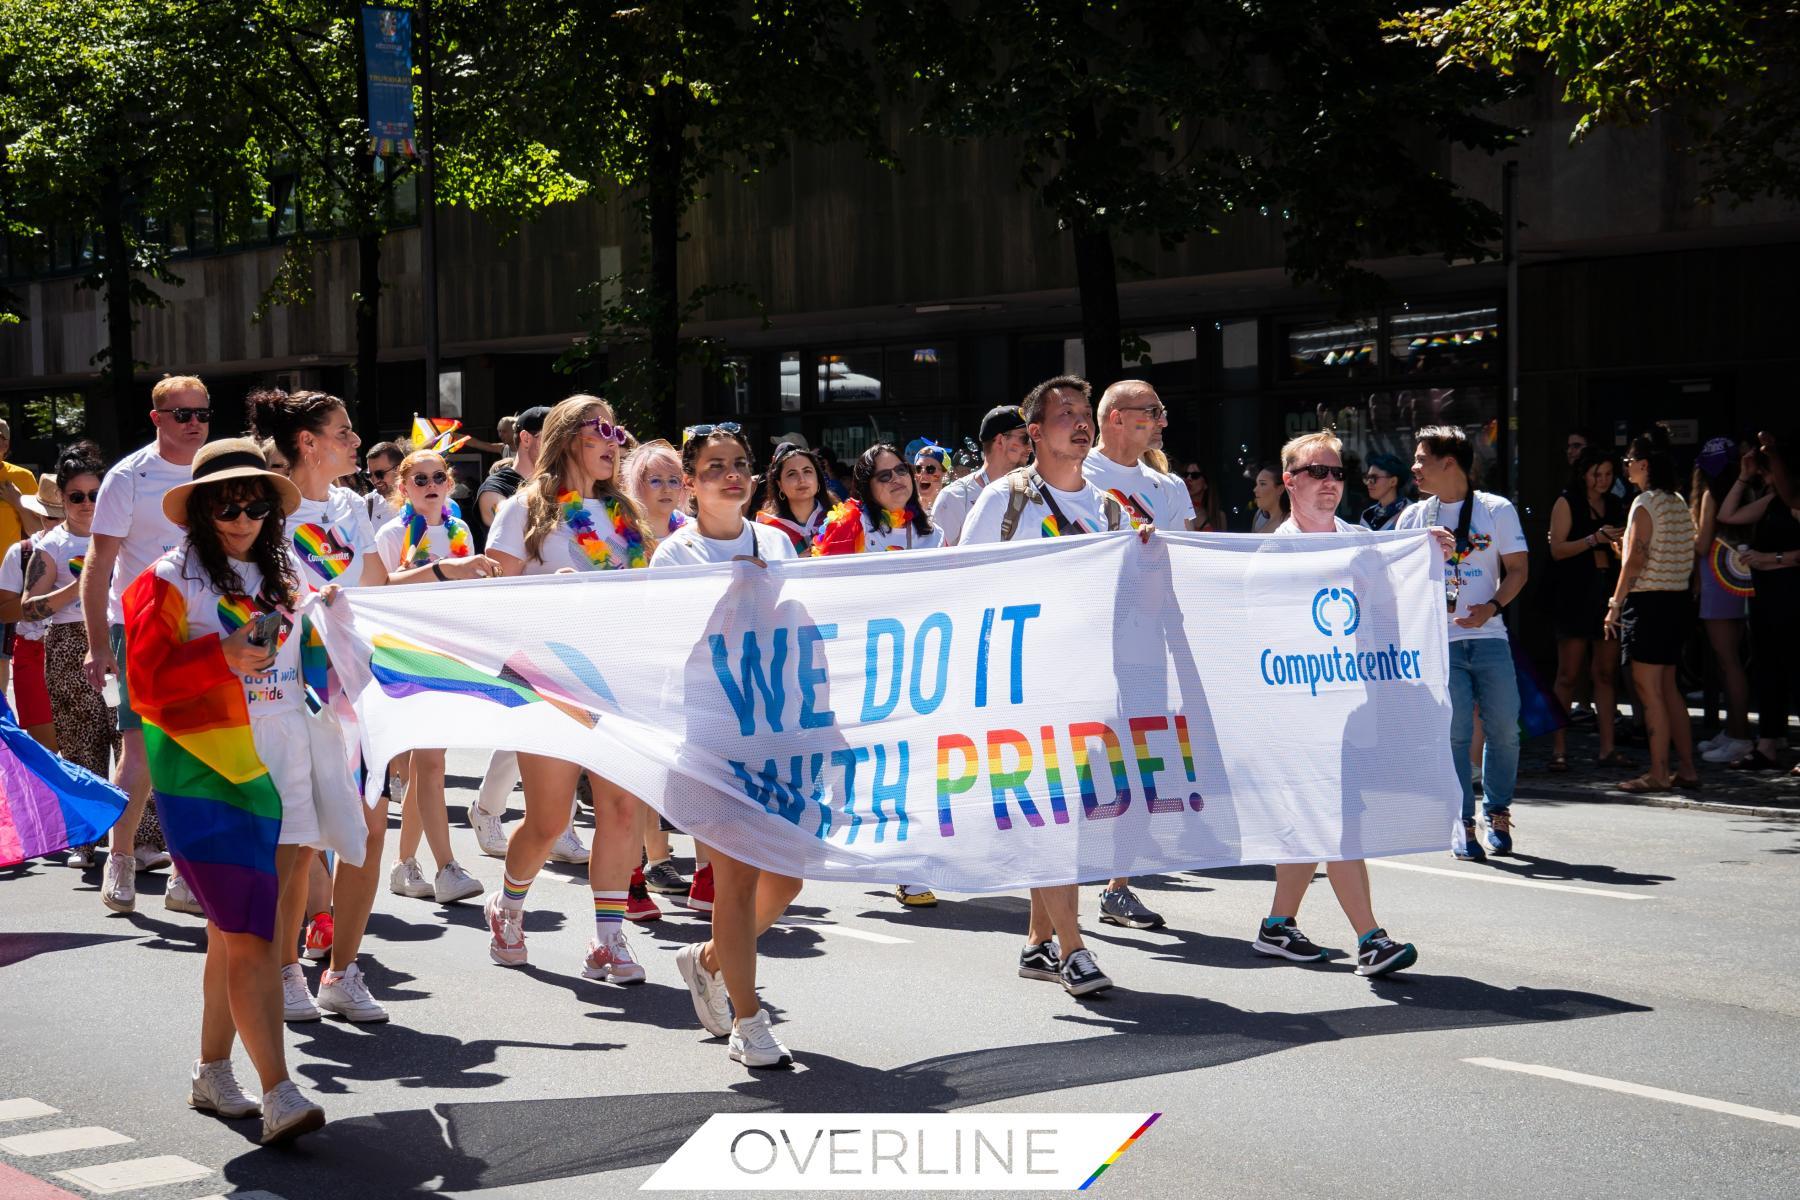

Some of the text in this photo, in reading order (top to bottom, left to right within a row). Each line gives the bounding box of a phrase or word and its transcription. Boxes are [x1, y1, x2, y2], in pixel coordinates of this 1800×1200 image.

[248, 686, 284, 704] pride
[708, 603, 1042, 736] WE DO IT
[1260, 643, 1421, 697] Computacenter
[727, 714, 1204, 846] WITH PRIDE!
